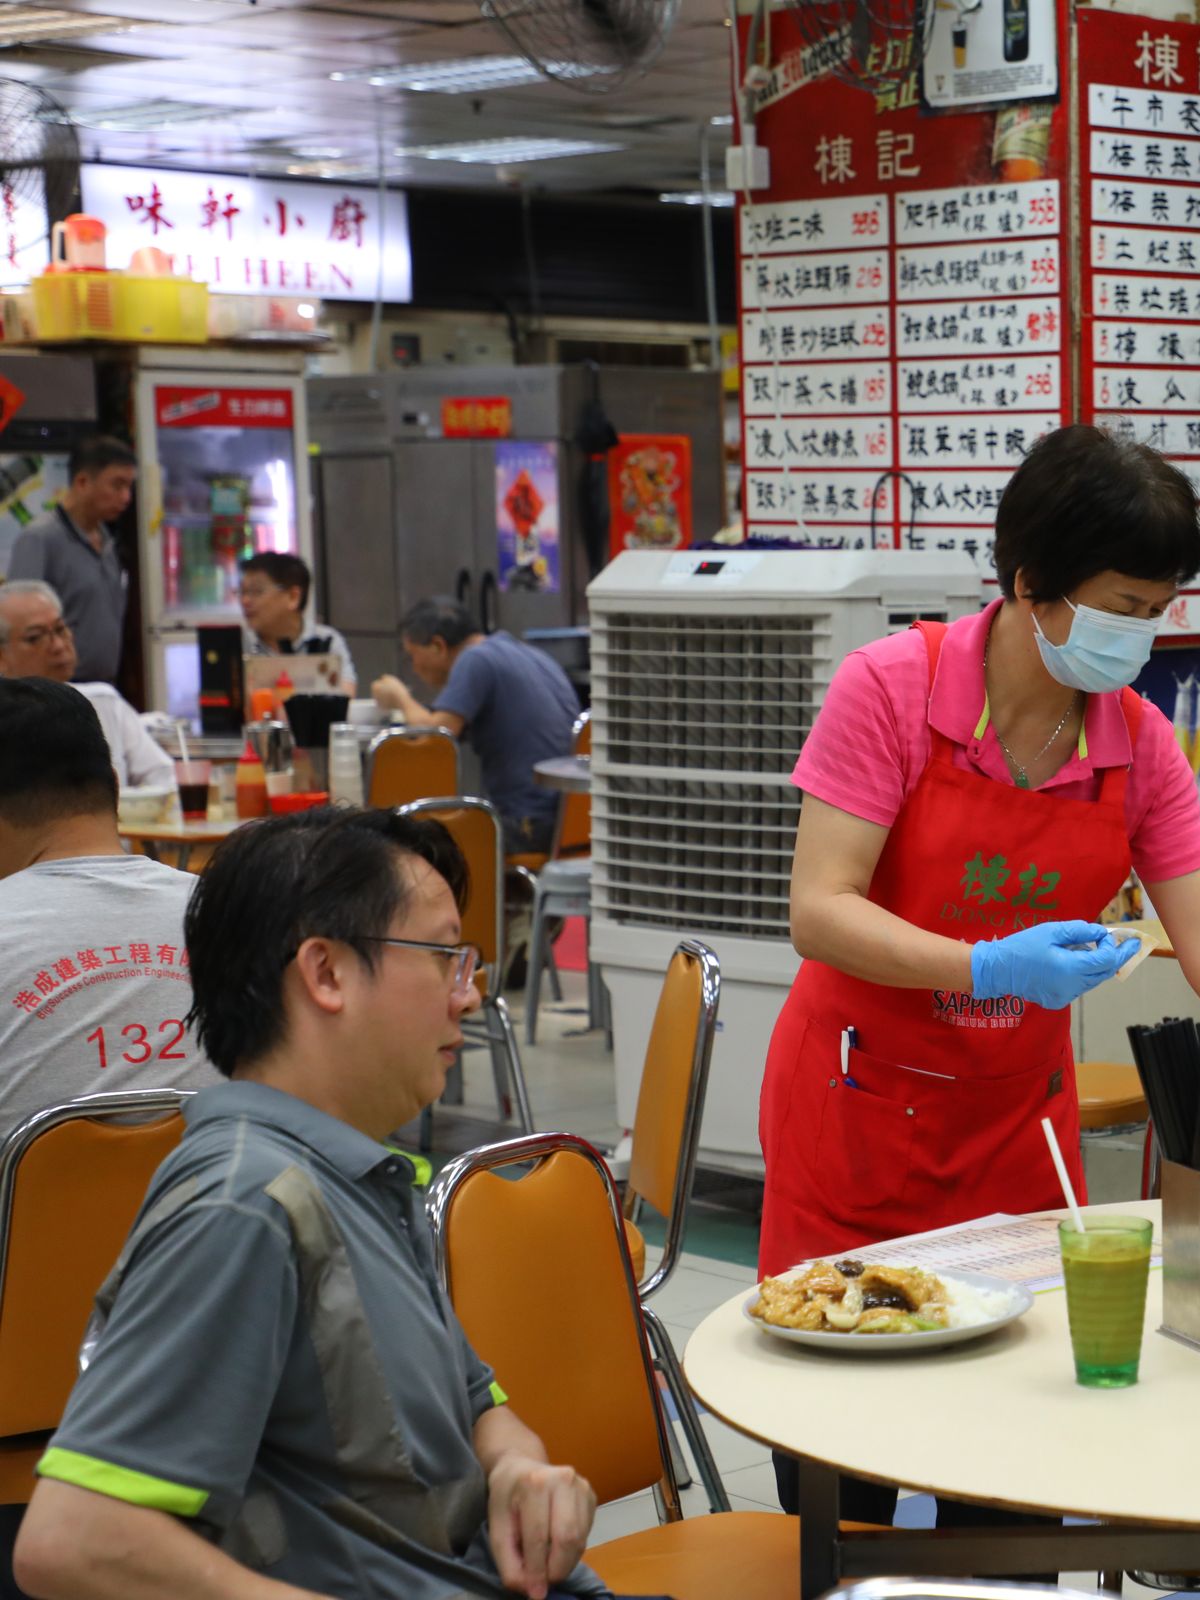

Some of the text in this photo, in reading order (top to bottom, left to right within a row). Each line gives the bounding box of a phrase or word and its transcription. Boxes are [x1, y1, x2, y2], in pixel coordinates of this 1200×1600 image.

[813, 130, 922, 184] 棟記
[244, 257, 353, 291] HEEN
[960, 851, 1061, 910] 棟記
[82, 968, 142, 987] Construction
[932, 989, 1025, 1018] SAPPORO
[87, 1019, 186, 1068] 132
